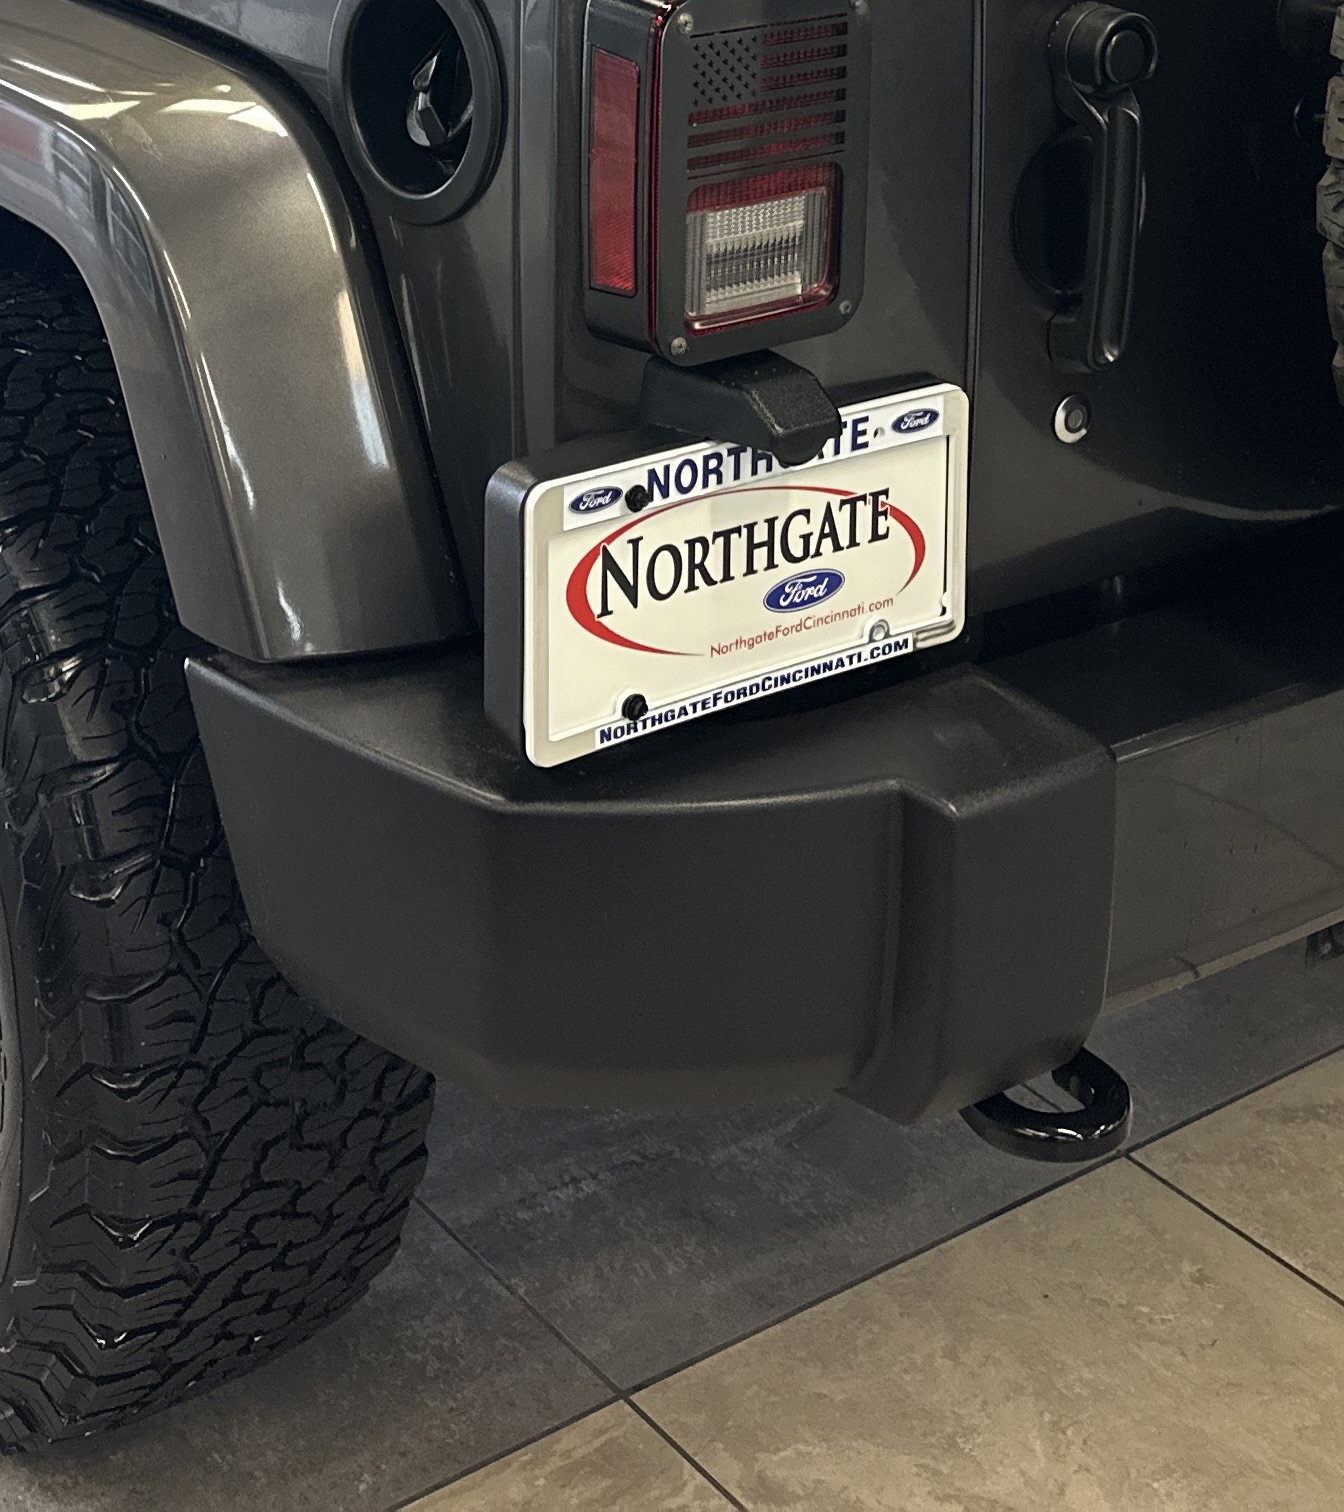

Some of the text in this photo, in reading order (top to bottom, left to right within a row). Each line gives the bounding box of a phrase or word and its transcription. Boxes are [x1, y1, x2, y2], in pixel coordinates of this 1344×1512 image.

[578, 409, 932, 512] Ford NORTHTE Ford
[596, 487, 890, 619] NORTHGATE
[779, 575, 829, 607] Ford
[710, 596, 895, 658] NorthgateFordCincinnati.com
